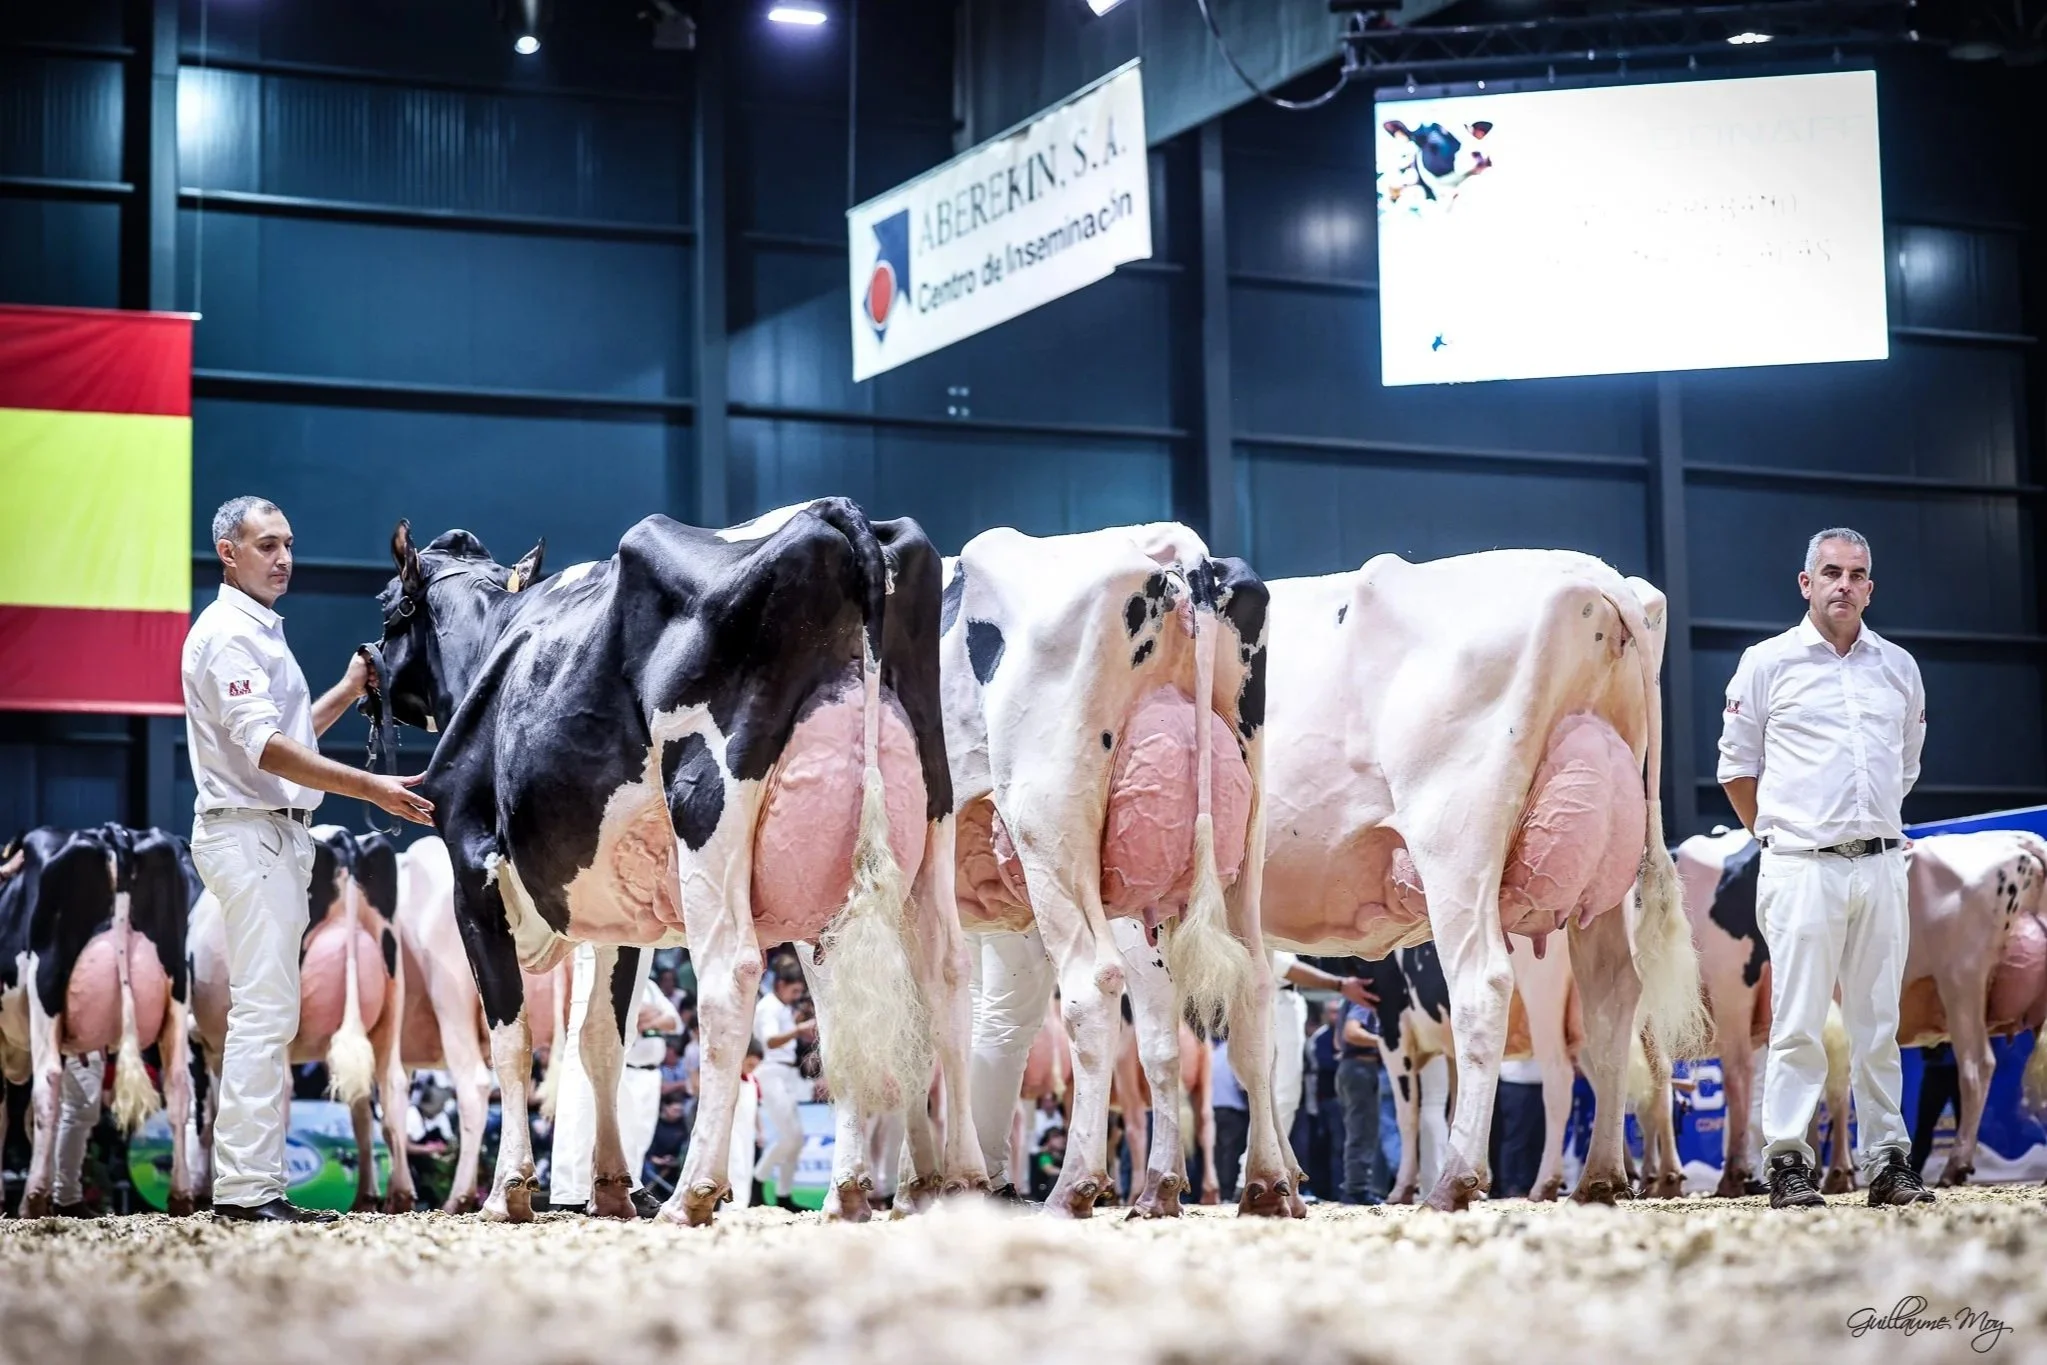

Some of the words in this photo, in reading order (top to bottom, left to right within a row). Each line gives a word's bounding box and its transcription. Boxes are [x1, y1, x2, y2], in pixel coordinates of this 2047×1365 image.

[918, 269, 976, 314] Centro
[982, 253, 1003, 286] de
[1006, 190, 1132, 275] Inseminacón
